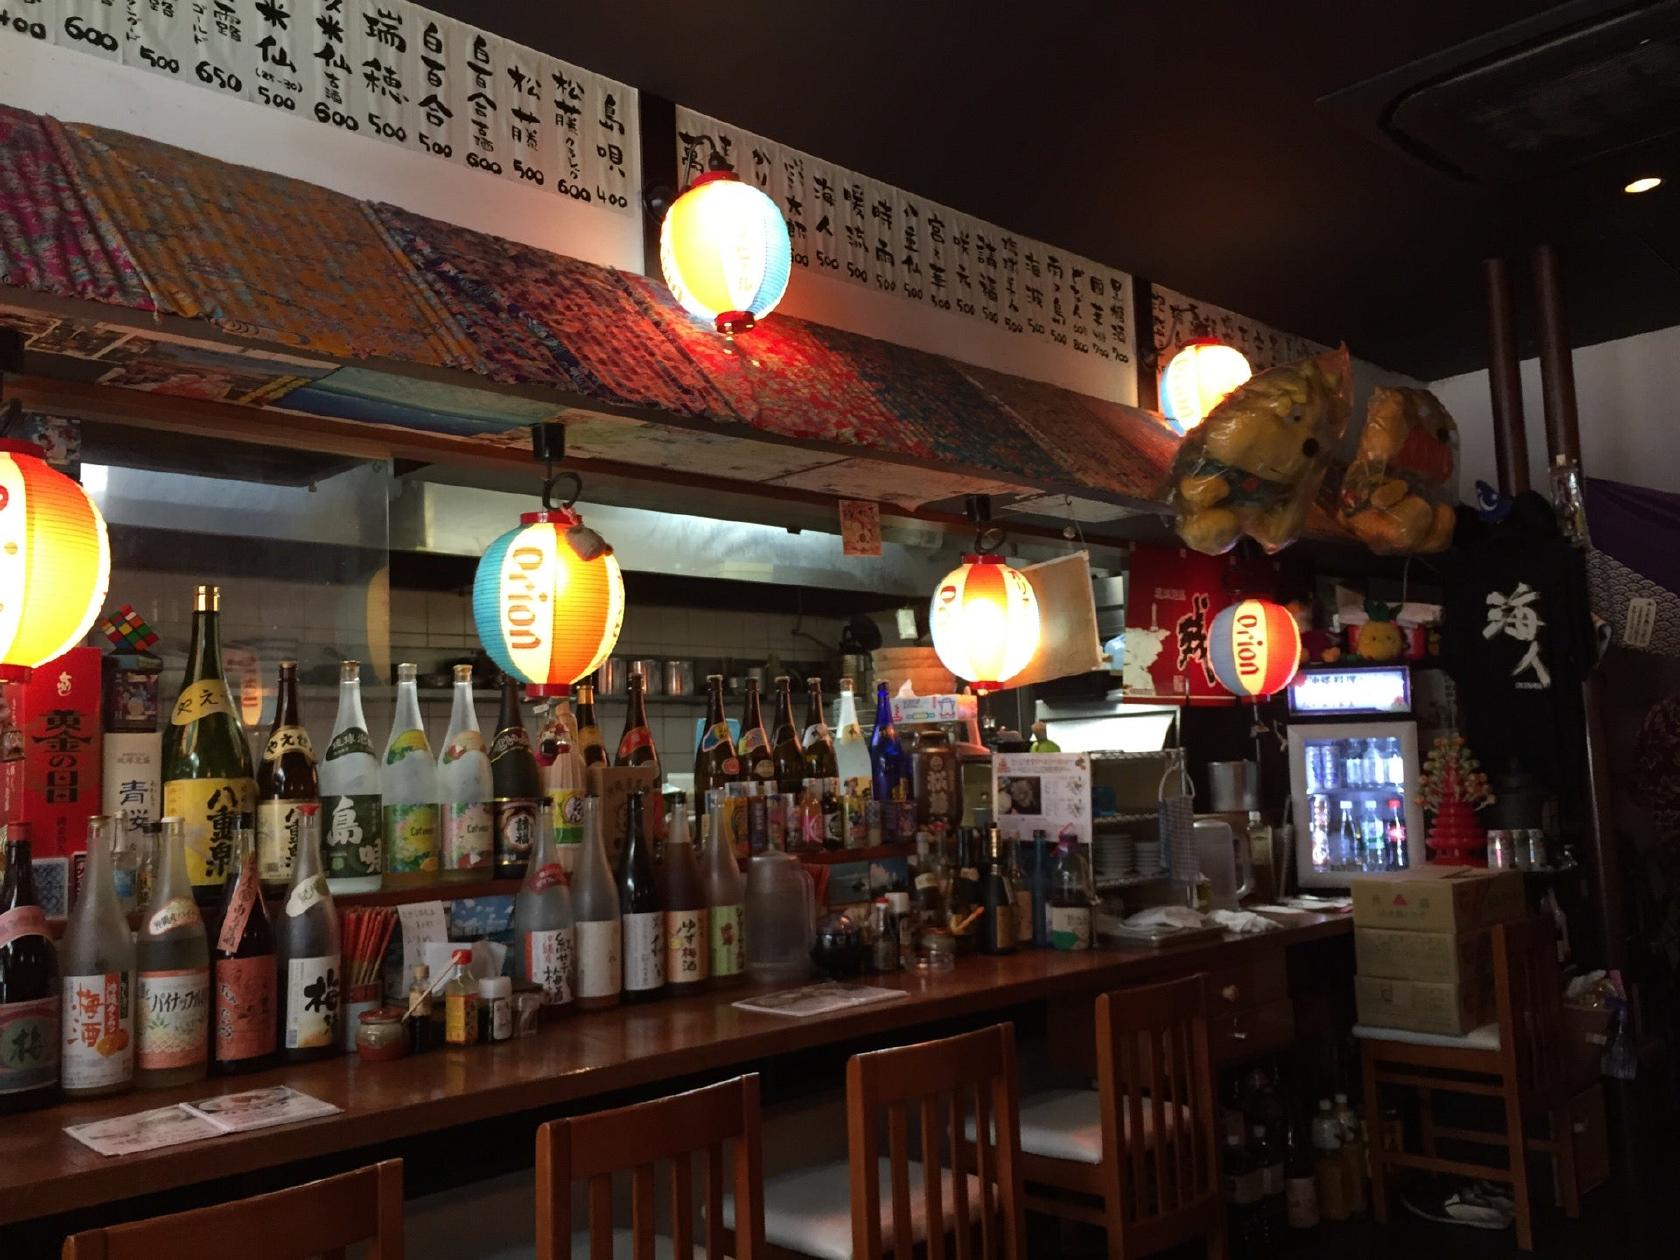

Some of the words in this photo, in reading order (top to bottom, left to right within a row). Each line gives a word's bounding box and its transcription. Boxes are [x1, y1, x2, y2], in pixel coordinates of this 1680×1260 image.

[64, 16, 118, 51] 600
[140, 45, 180, 74] 500
[195, 61, 243, 92] 650
[258, 86, 296, 110] 500
[314, 102, 359, 131] 600
[368, 113, 407, 142] 500
[419, 132, 453, 158] 500
[466, 152, 502, 175] 600
[512, 159, 544, 185] 500
[557, 178, 591, 203] 600
[596, 185, 628, 208] 400
[817, 251, 839, 269] 500
[847, 261, 868, 283] 500
[876, 274, 896, 292] 500
[904, 282, 923, 300] 500
[931, 294, 951, 310] 500
[508, 547, 548, 649] Orion
[1236, 614, 1264, 676] Orion
[1481, 581, 1551, 688] 海人
